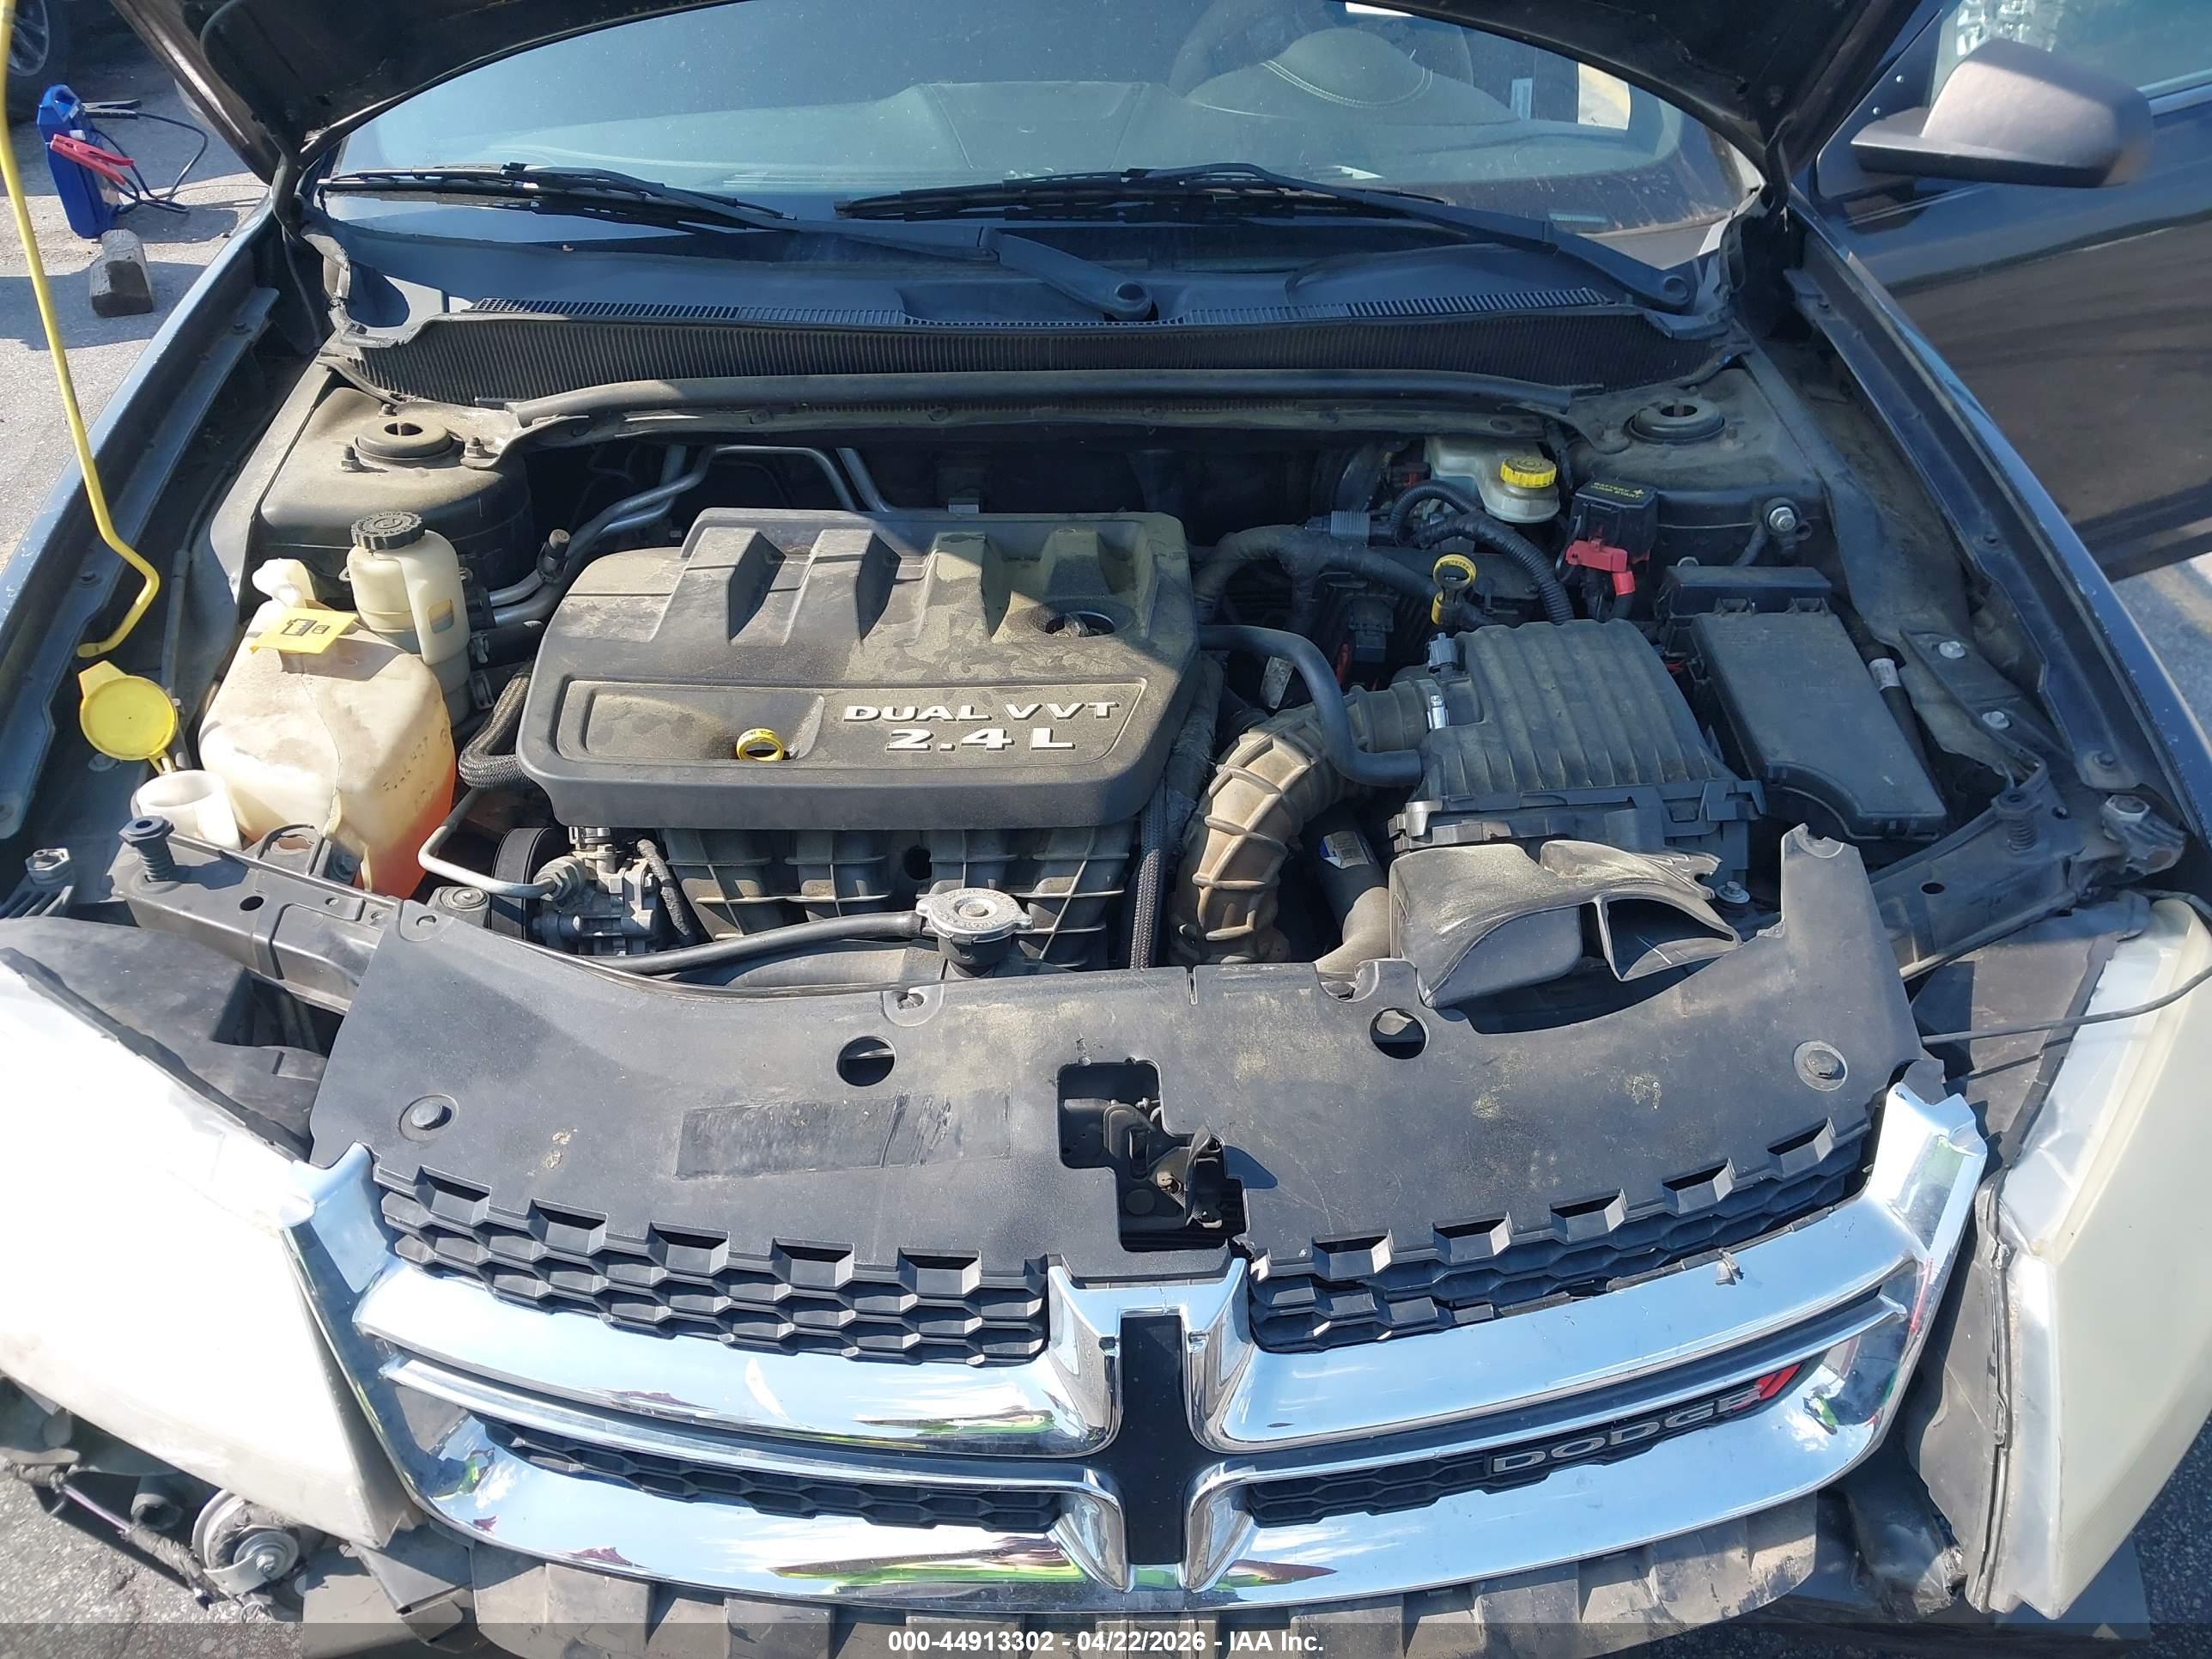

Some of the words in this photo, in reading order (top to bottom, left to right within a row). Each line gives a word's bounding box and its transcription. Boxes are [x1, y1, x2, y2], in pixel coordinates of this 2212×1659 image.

[844, 704, 992, 722] DUAL
[1005, 702, 1120, 721] VVT
[1492, 1383, 1761, 1473] DODGE
